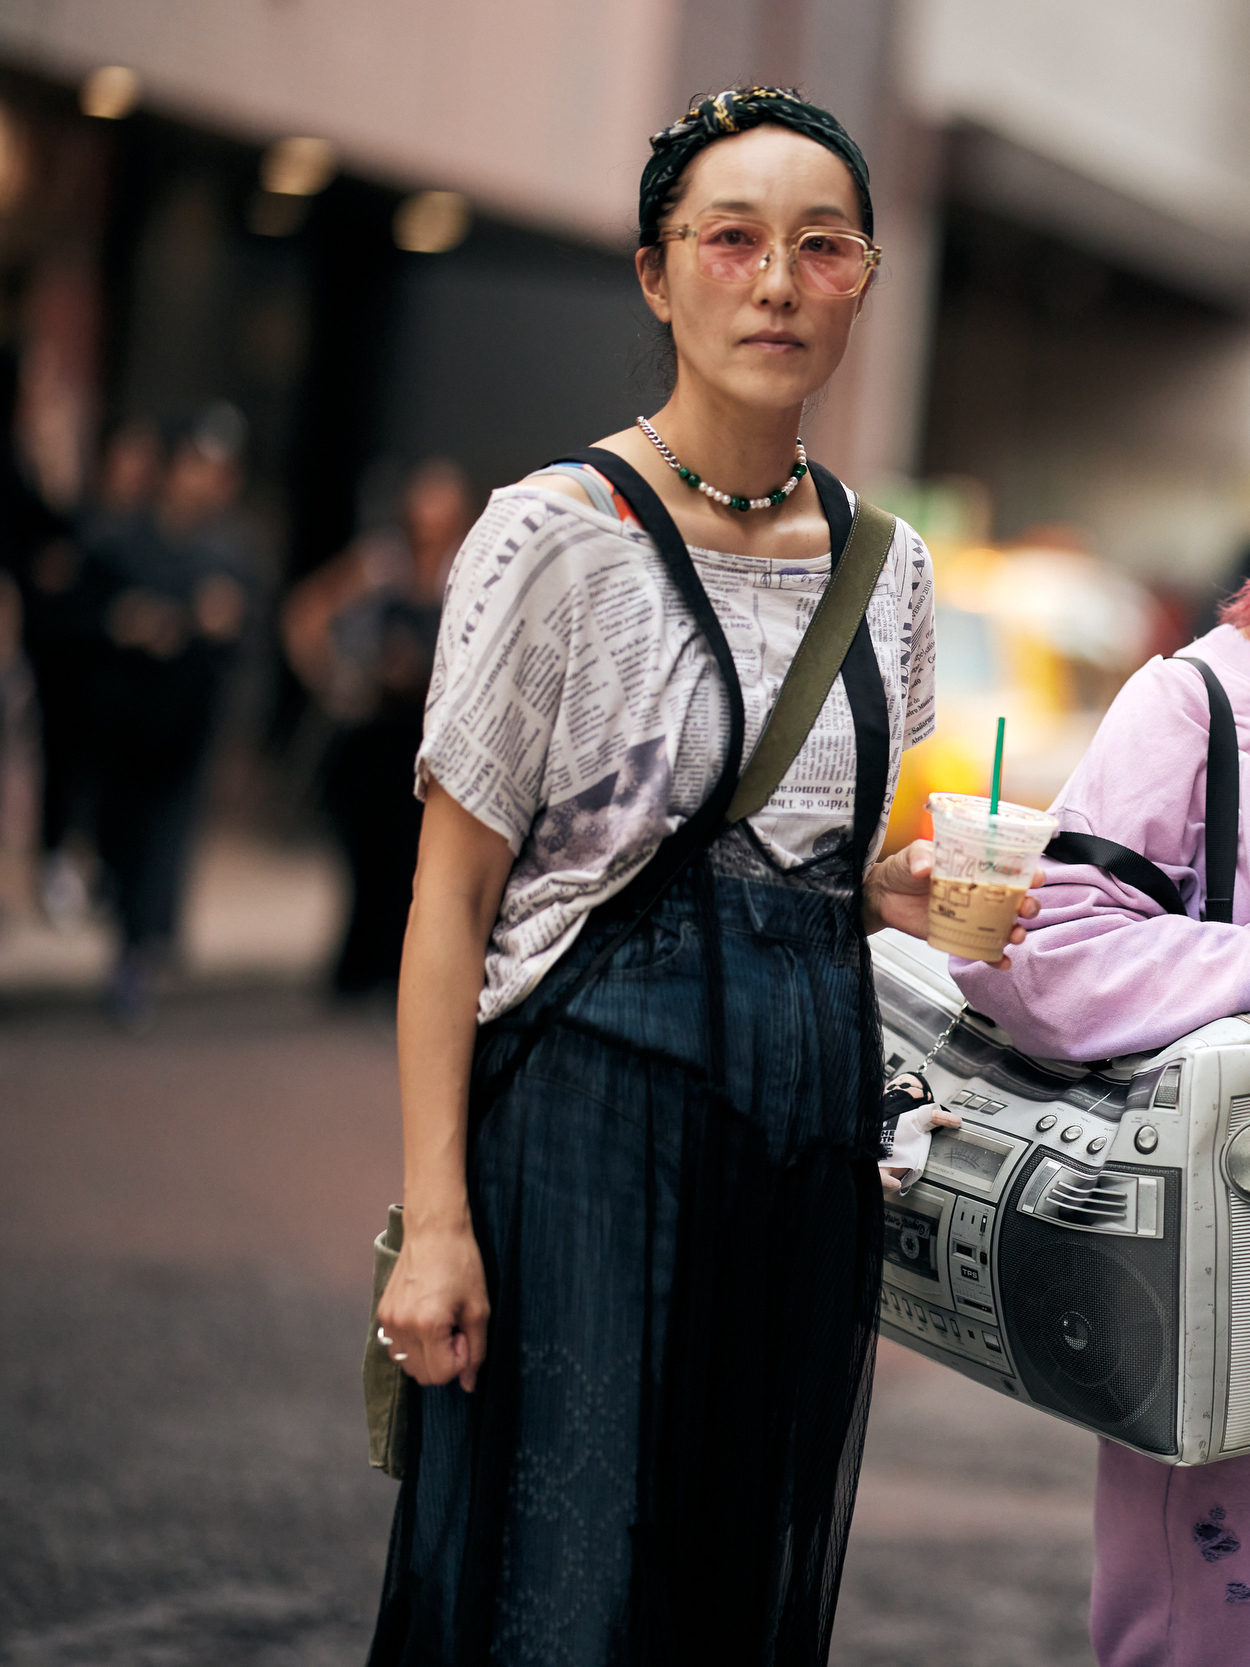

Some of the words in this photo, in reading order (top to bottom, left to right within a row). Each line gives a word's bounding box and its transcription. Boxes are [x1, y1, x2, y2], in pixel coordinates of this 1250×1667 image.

[912, 596, 925, 621] VERNO
[923, 580, 933, 598] 2010
[799, 800, 814, 809] de
[817, 800, 850, 811] vidro
[962, 1267, 978, 1280] TPS
